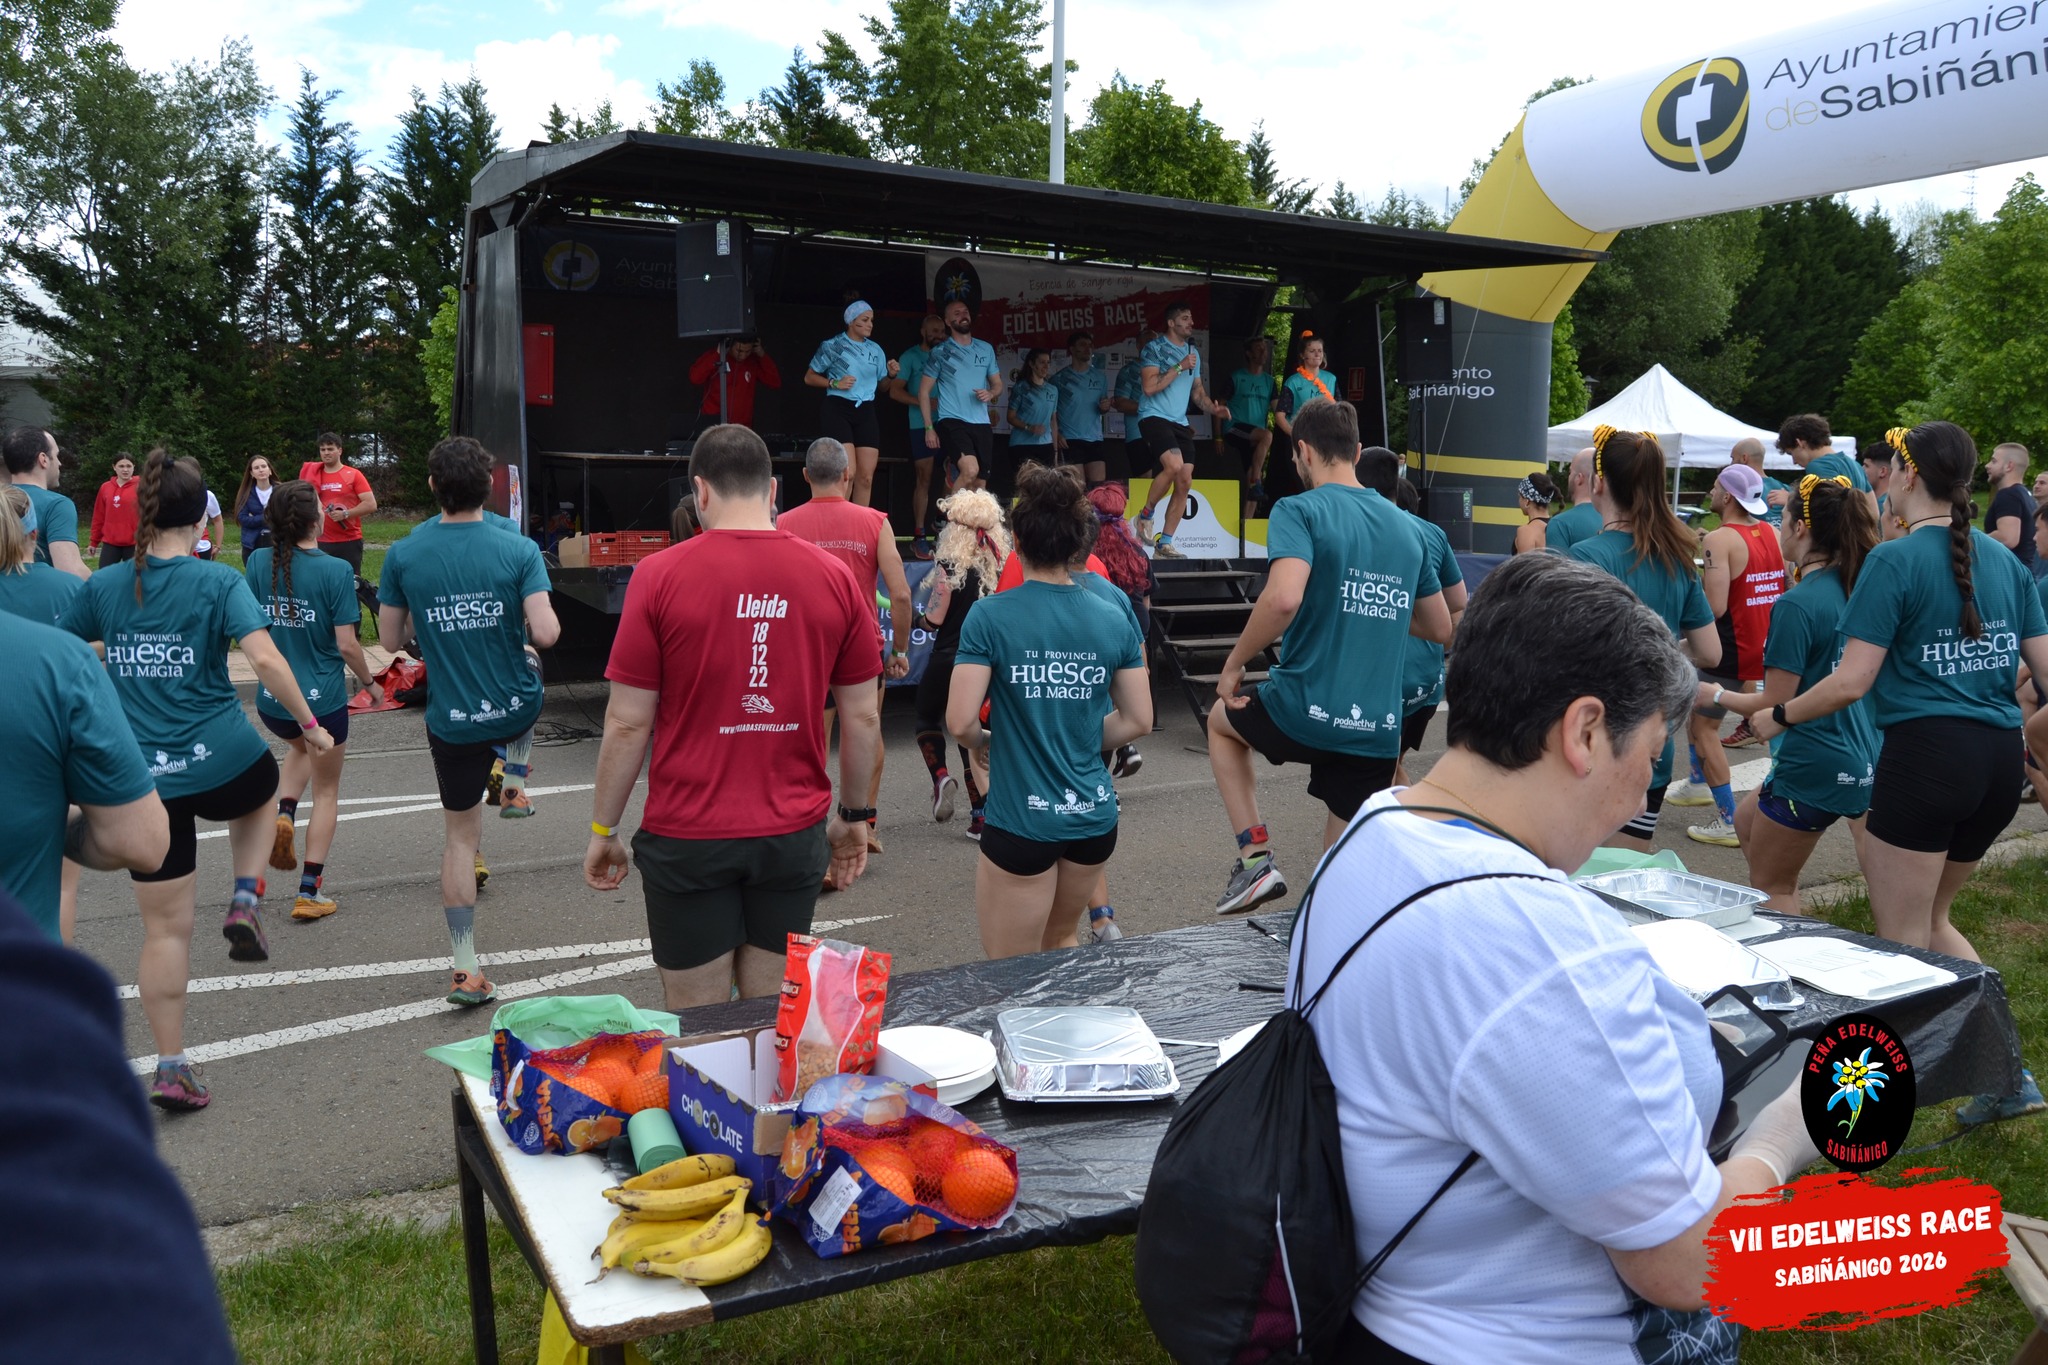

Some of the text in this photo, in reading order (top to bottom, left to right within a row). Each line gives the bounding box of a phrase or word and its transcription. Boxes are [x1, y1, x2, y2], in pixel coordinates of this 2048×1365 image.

[615, 257, 677, 273] Ayunt
[1066, 278, 1076, 289] de
[1003, 302, 1146, 335] EDELWEISS RACE
[736, 593, 788, 618] Lleida
[752, 622, 769, 644] 18
[752, 644, 768, 665] 12
[749, 666, 768, 688] 22
[1333, 717, 1377, 729] podoactiva
